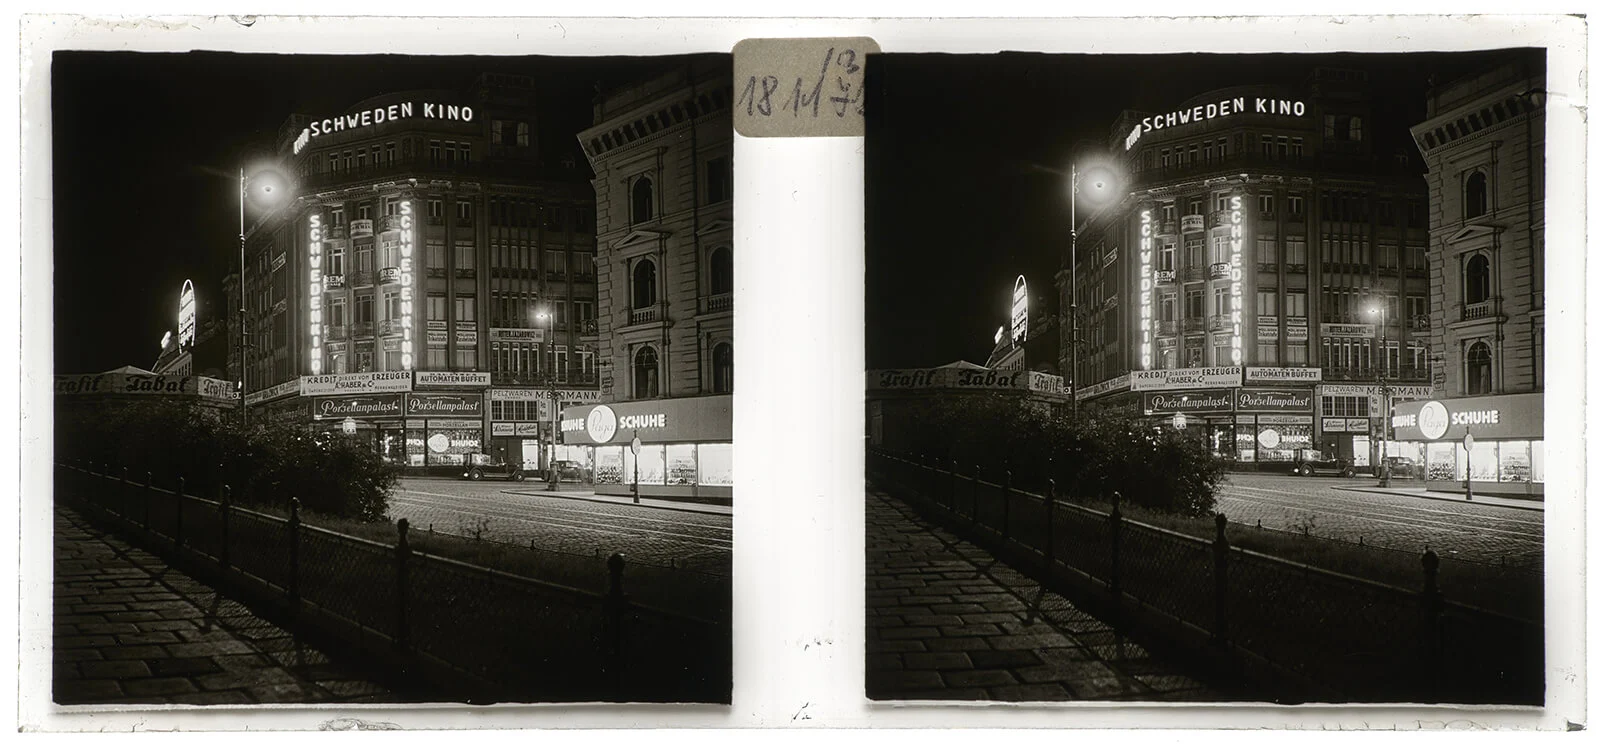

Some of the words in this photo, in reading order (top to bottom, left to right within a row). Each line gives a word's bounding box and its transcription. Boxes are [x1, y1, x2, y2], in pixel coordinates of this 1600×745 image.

[310, 102, 413, 137] SCHWEDEN
[424, 102, 473, 122] KINO
[1142, 97, 1245, 133] SCHWEDEN
[1256, 97, 1305, 117] KINO
[307, 376, 337, 384] KREDIT
[372, 372, 410, 380] ERZEUGER
[1138, 371, 1167, 379] KREDIT
[1202, 368, 1240, 376] ERZEUGER
[547, 391, 597, 399] BRMANN
[1378, 387, 1430, 395] BRMANN
[619, 414, 666, 429] SCHUHE
[1452, 410, 1499, 425] SCHUHE
